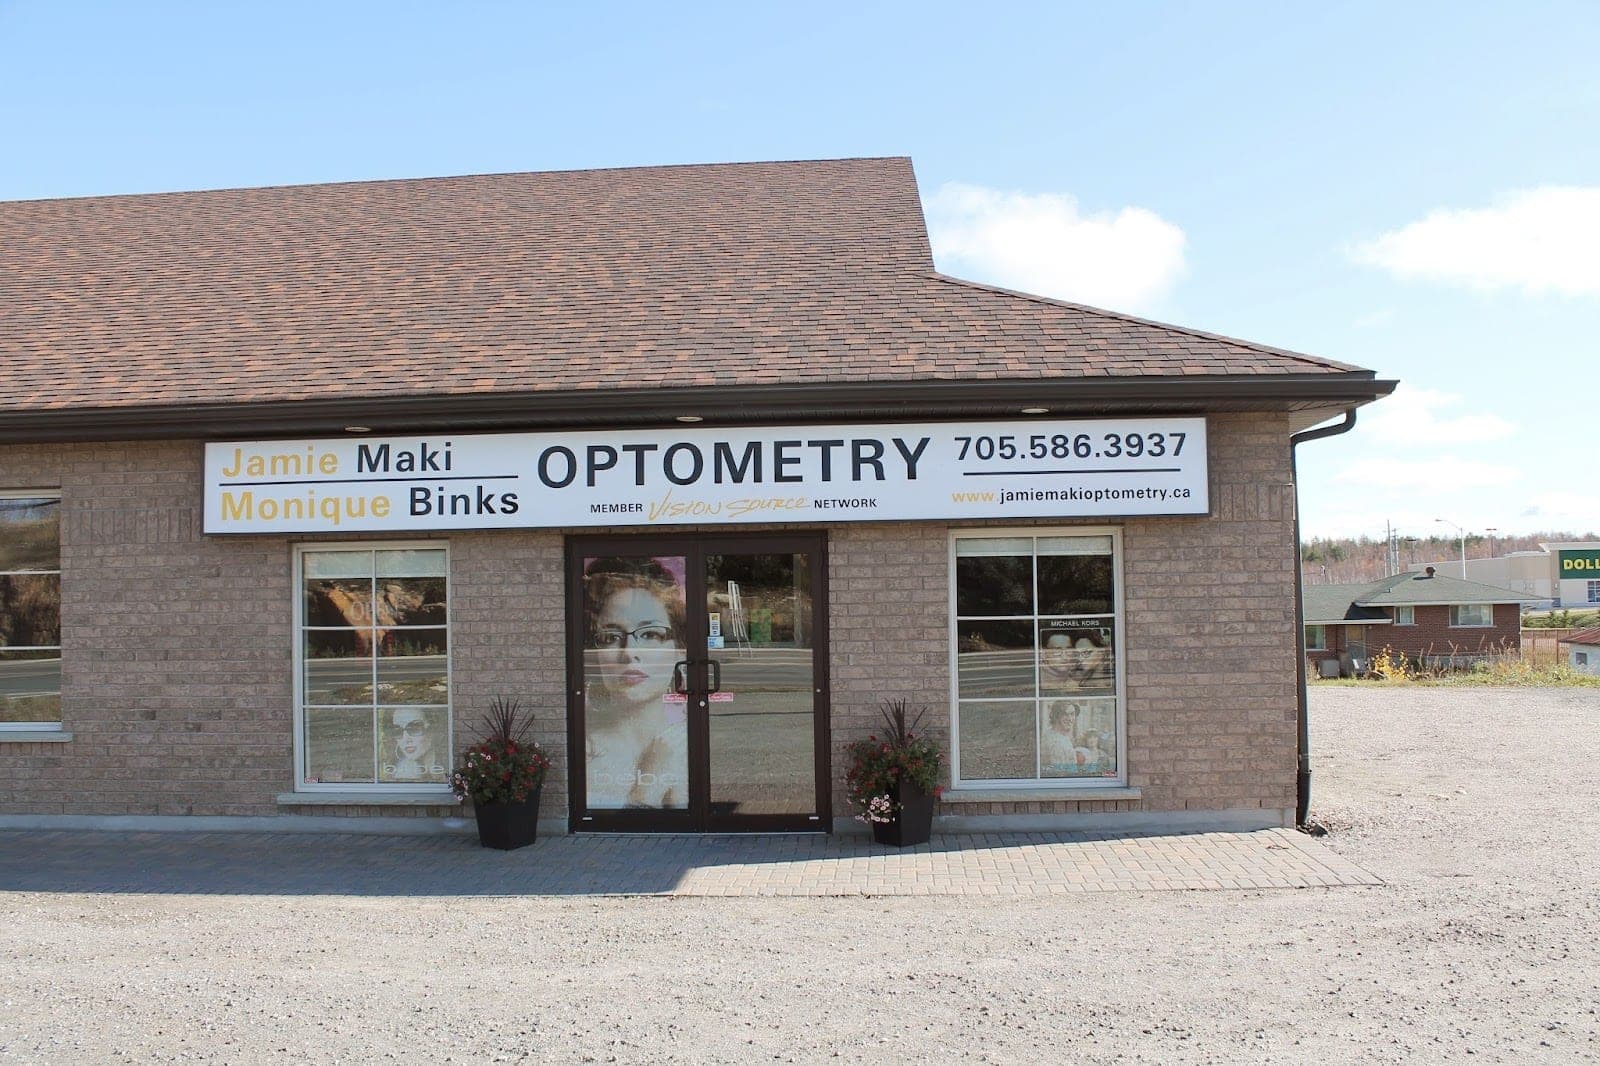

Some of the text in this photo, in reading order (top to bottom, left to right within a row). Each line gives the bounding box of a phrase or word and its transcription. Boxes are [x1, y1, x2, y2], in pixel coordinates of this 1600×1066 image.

[221, 442, 453, 478] Jamie Maki
[953, 432, 1188, 461] 705.586.3937
[537, 437, 932, 489] OPTOMETRY
[220, 484, 520, 526] Monique Binks
[590, 502, 644, 514] MEMBER
[813, 497, 878, 509] NETWORK
[951, 486, 1192, 505] www.jamiemakioptometry.ca
[1081, 619, 1100, 627] KORS
